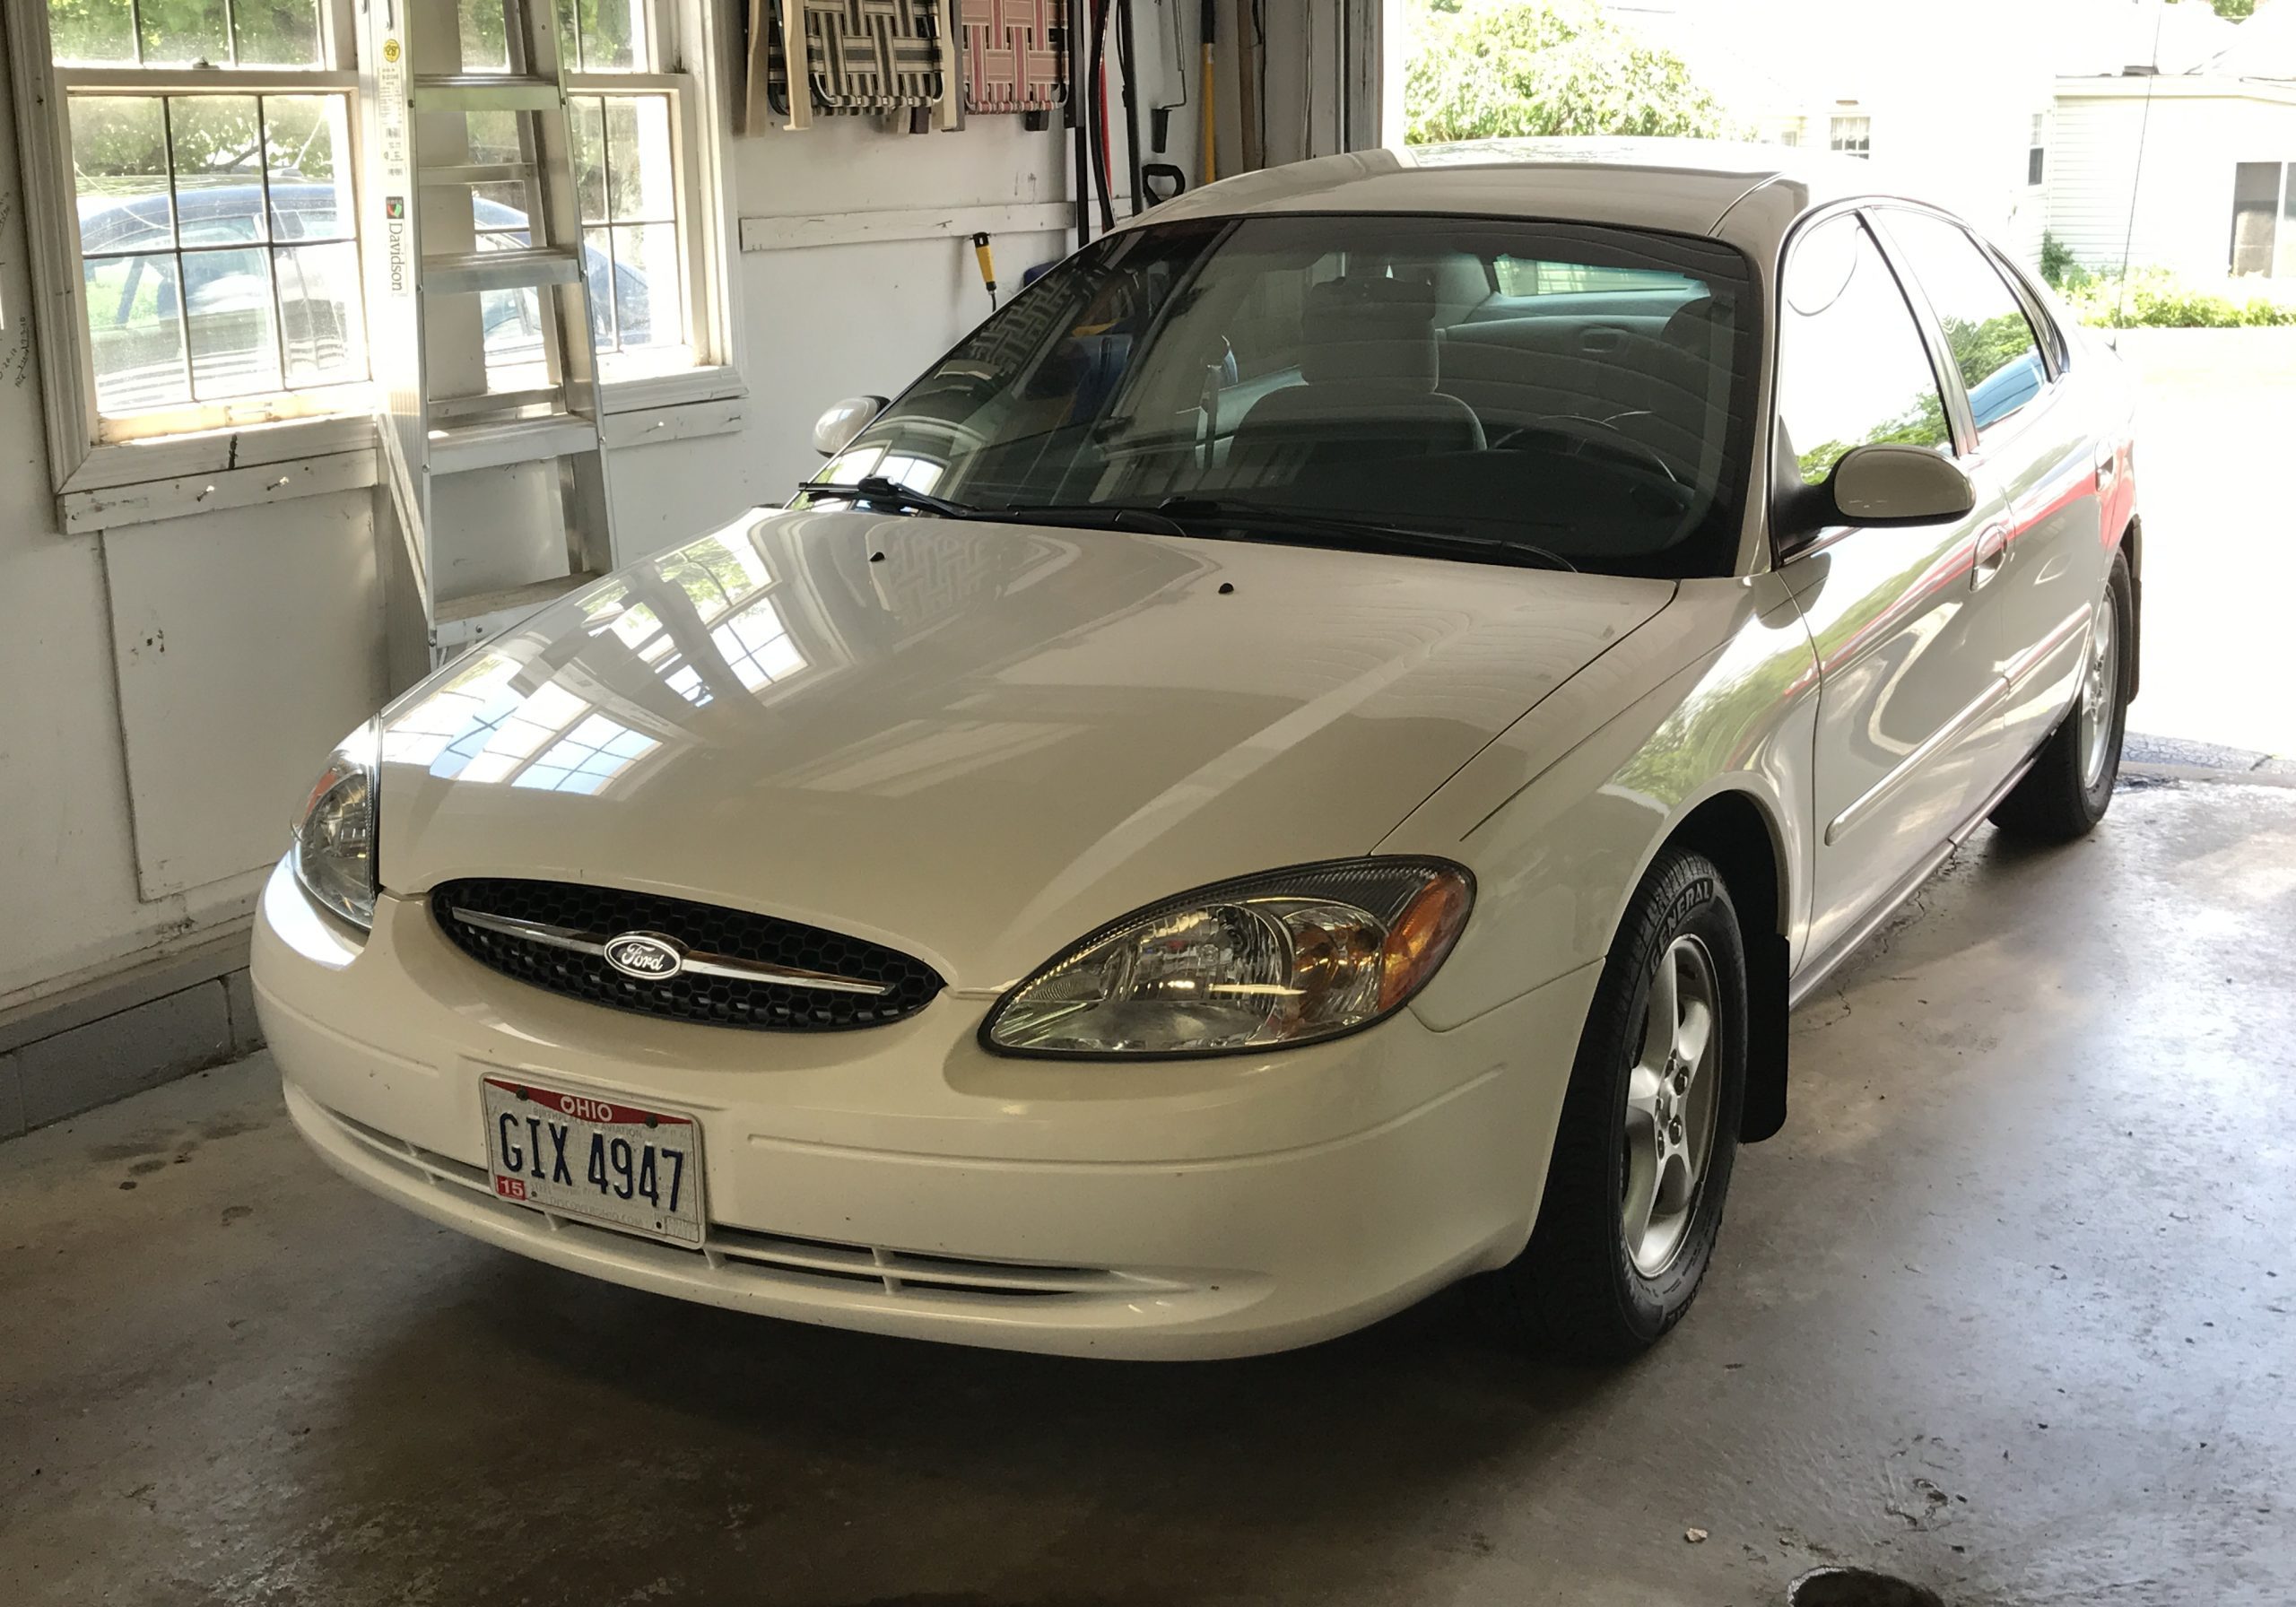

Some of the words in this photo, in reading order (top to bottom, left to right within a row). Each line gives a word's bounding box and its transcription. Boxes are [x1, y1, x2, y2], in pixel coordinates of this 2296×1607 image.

[388, 222, 404, 291] Davidson
[1651, 881, 1710, 976] GENERAL
[622, 942, 665, 970] Ford
[560, 1096, 613, 1122] OHIO
[500, 1111, 572, 1186] GIX
[588, 1130, 683, 1212] 4947
[500, 1179, 524, 1197] 15
